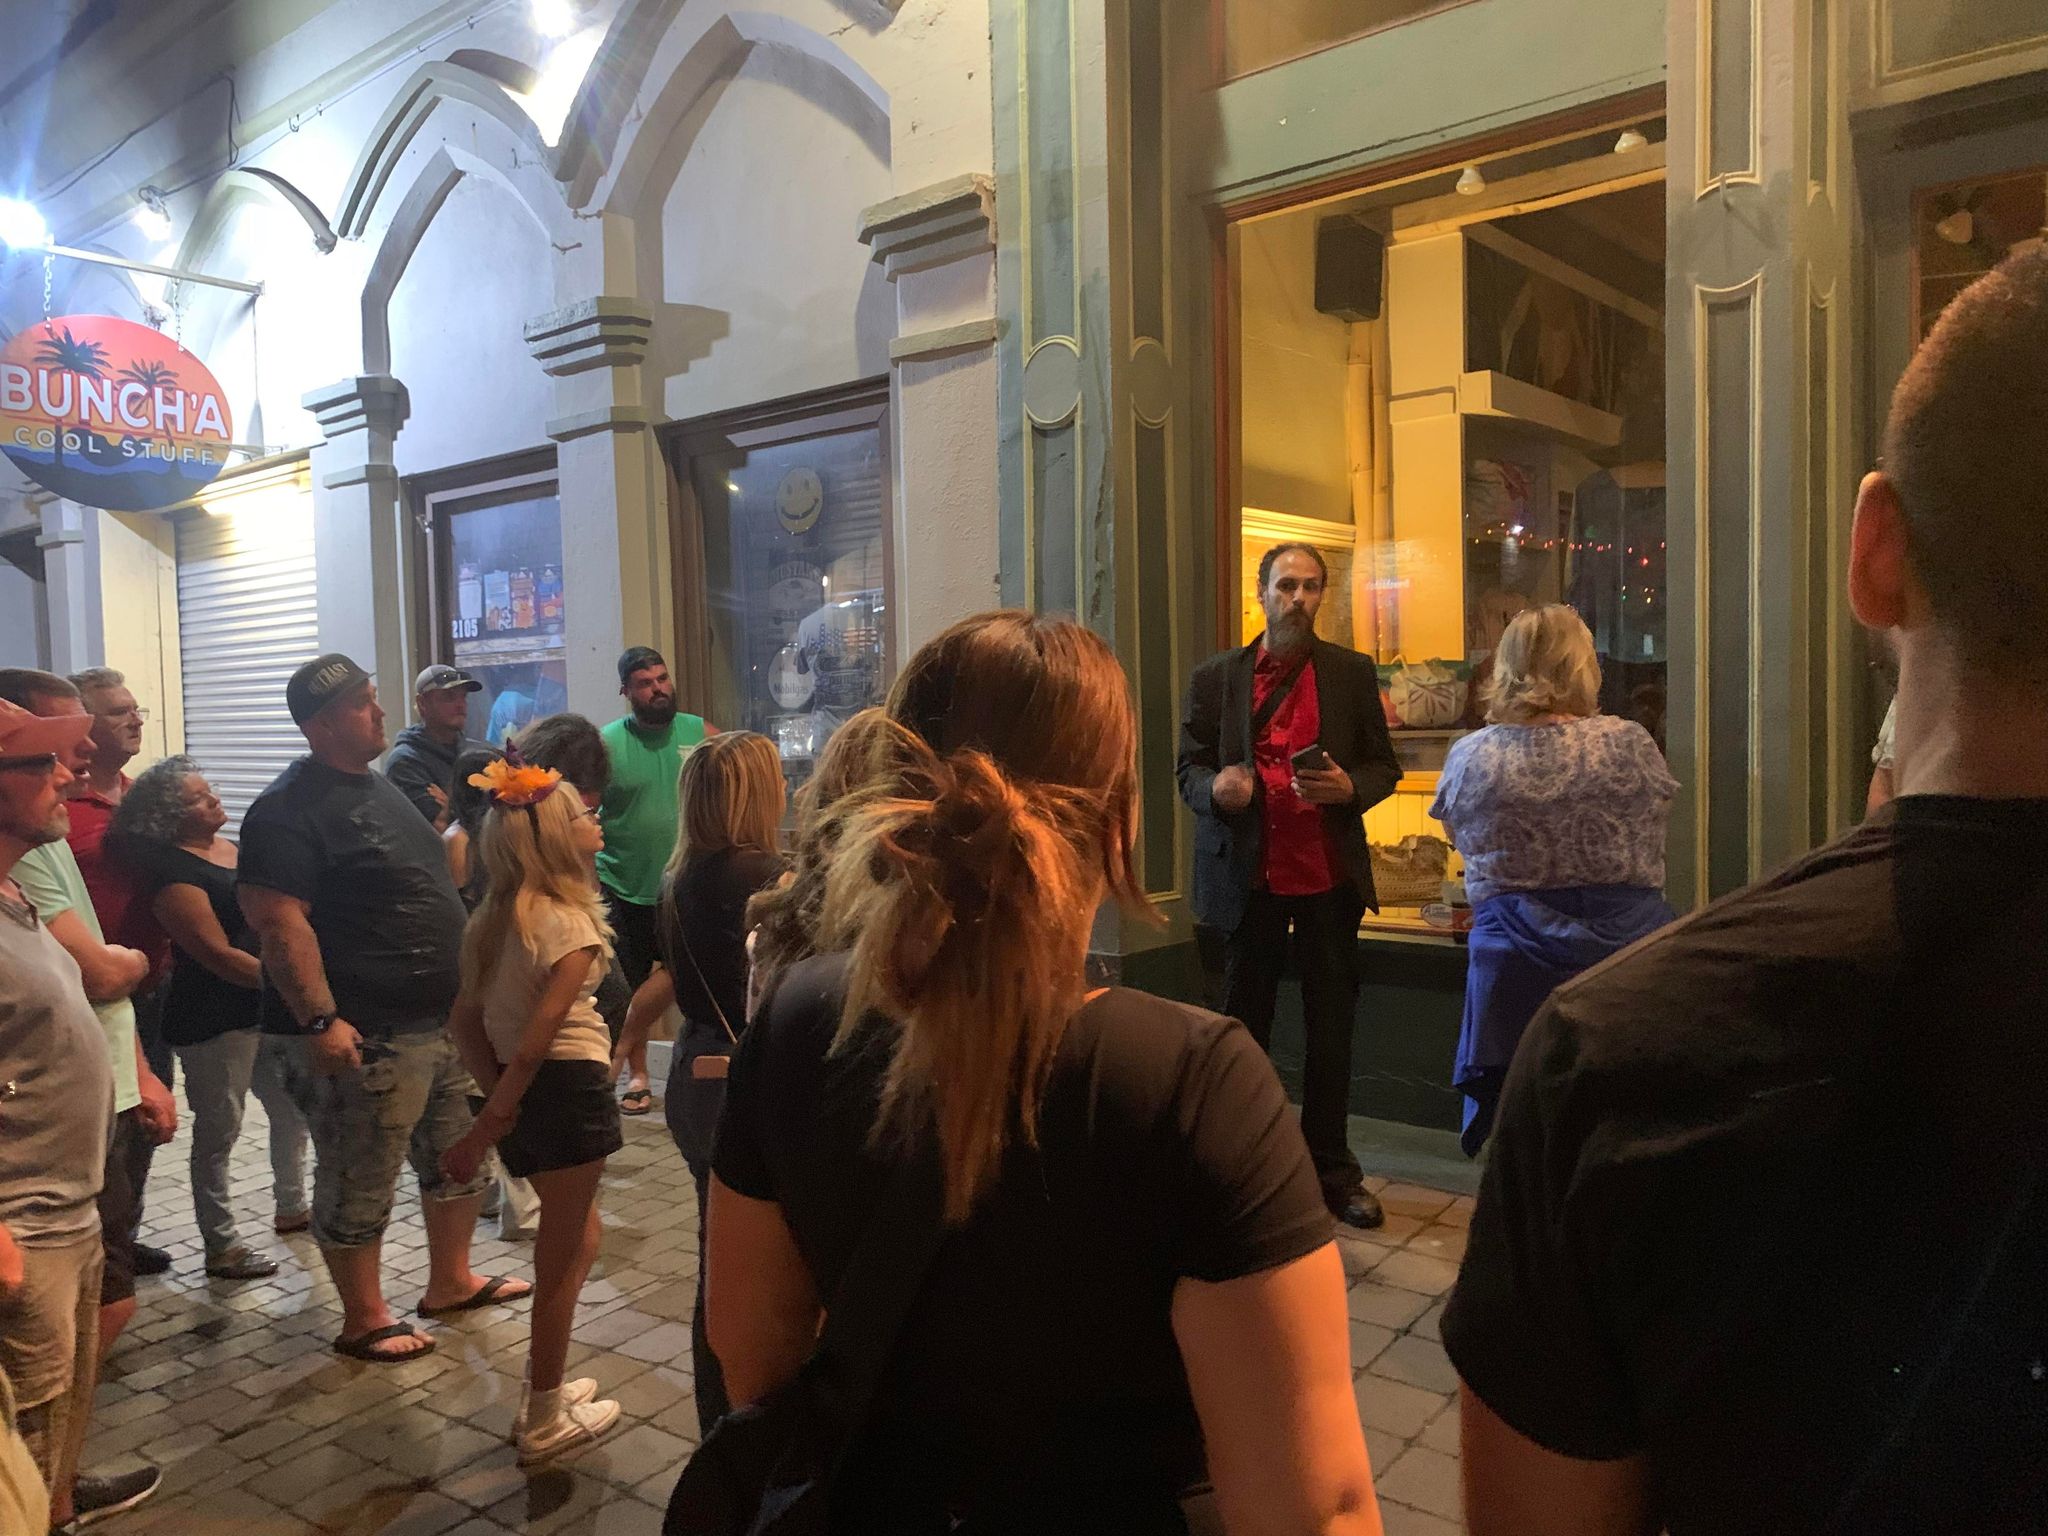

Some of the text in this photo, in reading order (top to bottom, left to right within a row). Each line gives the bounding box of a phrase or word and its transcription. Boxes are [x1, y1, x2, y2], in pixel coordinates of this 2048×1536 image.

[0, 364, 229, 438] BUNCH'A
[14, 427, 214, 466] COOL STUFF
[452, 619, 479, 639] 2105
